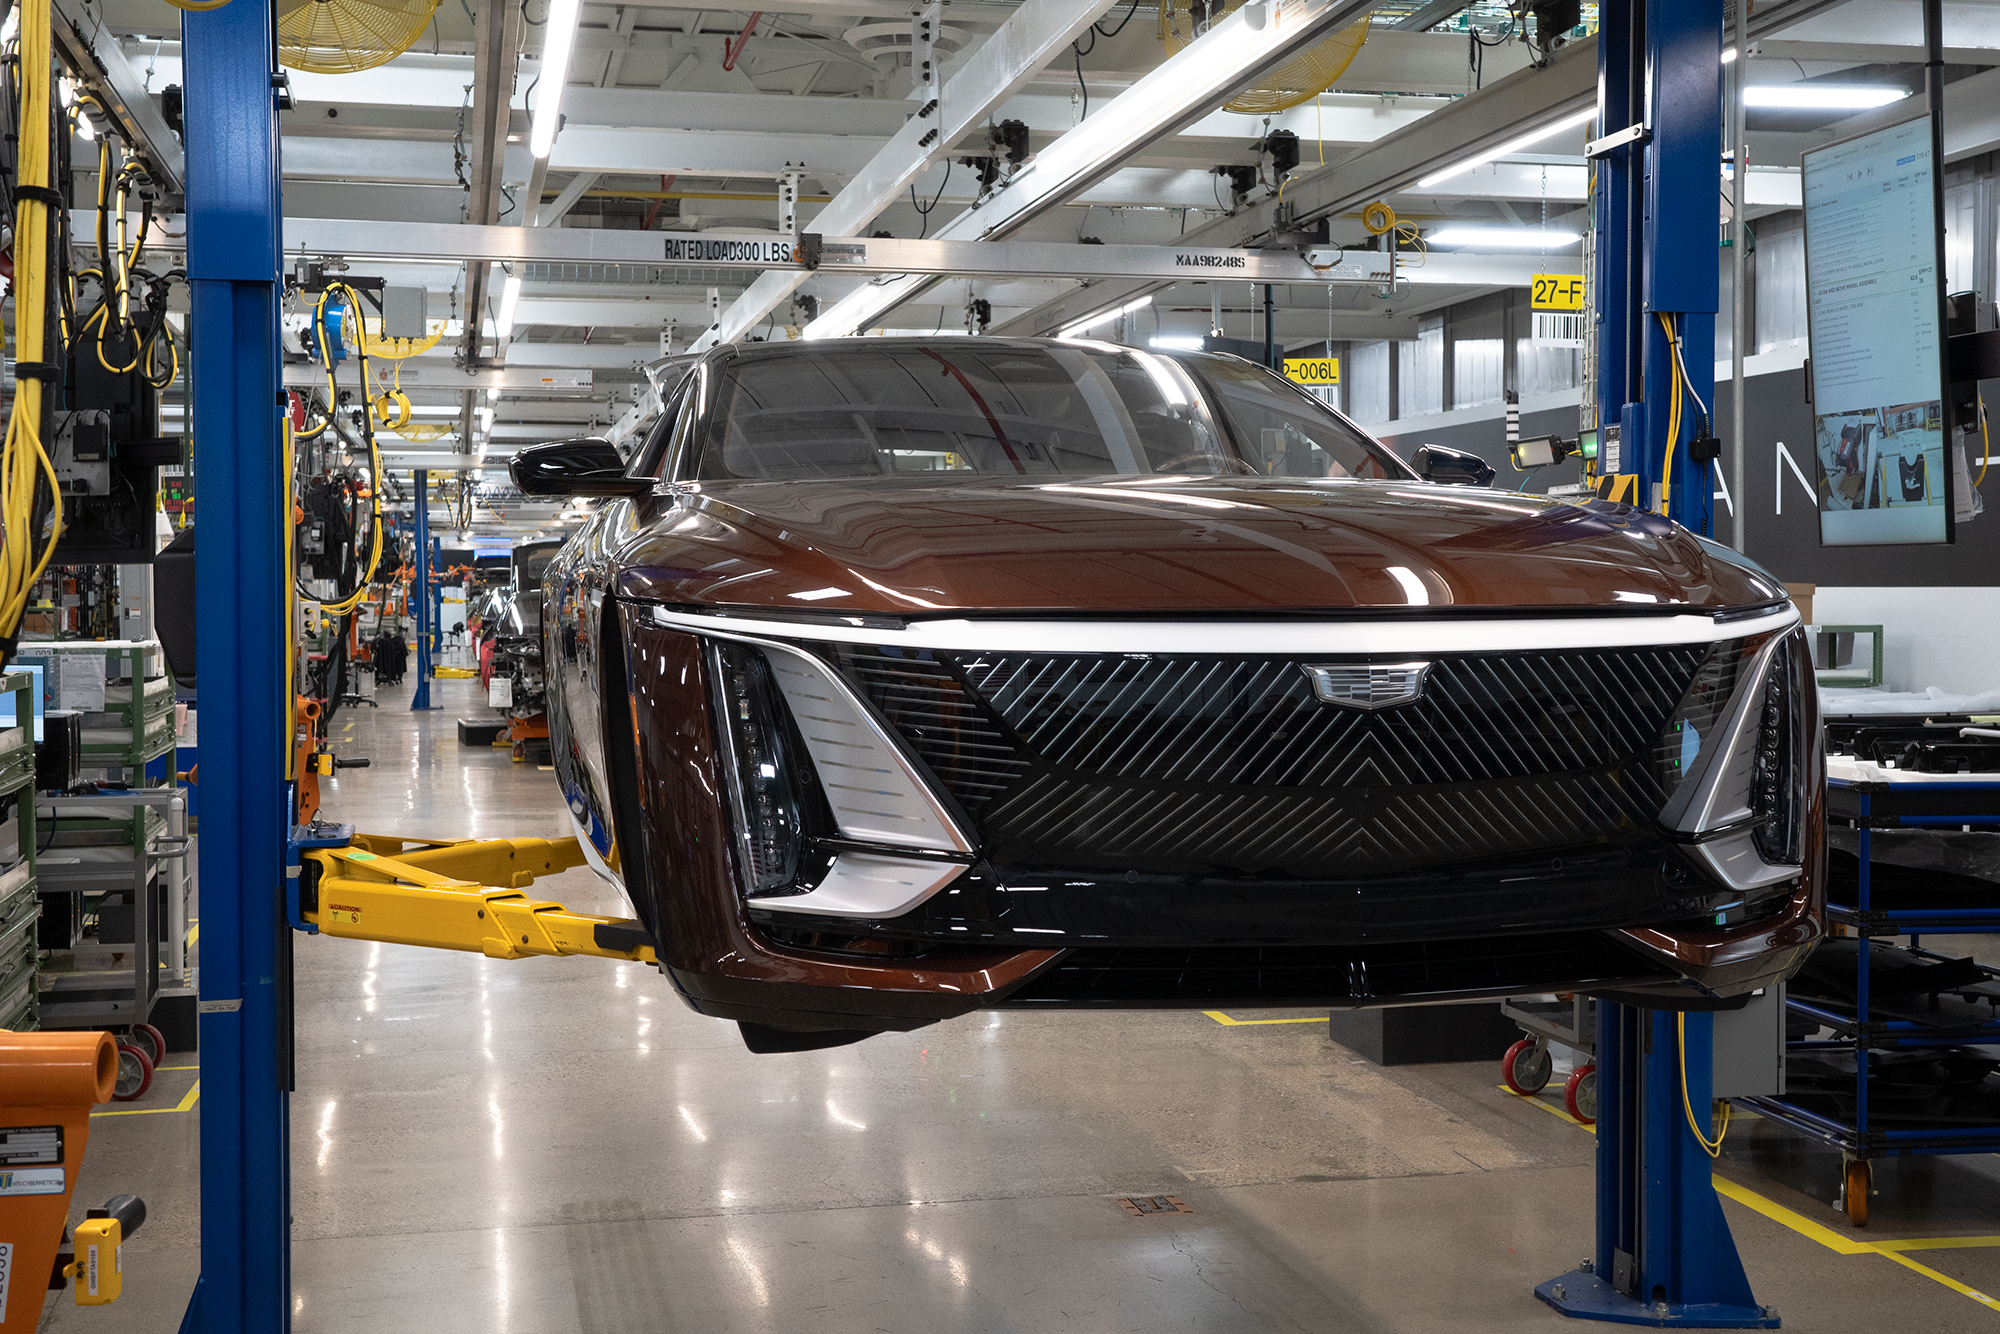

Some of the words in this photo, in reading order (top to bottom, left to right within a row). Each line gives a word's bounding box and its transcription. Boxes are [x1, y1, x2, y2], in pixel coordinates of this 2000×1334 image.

[665, 239, 703, 259] RATED
[763, 242, 793, 262] LBS.
[1534, 279, 1583, 304] 27-F
[333, 904, 360, 912] CAUTION
